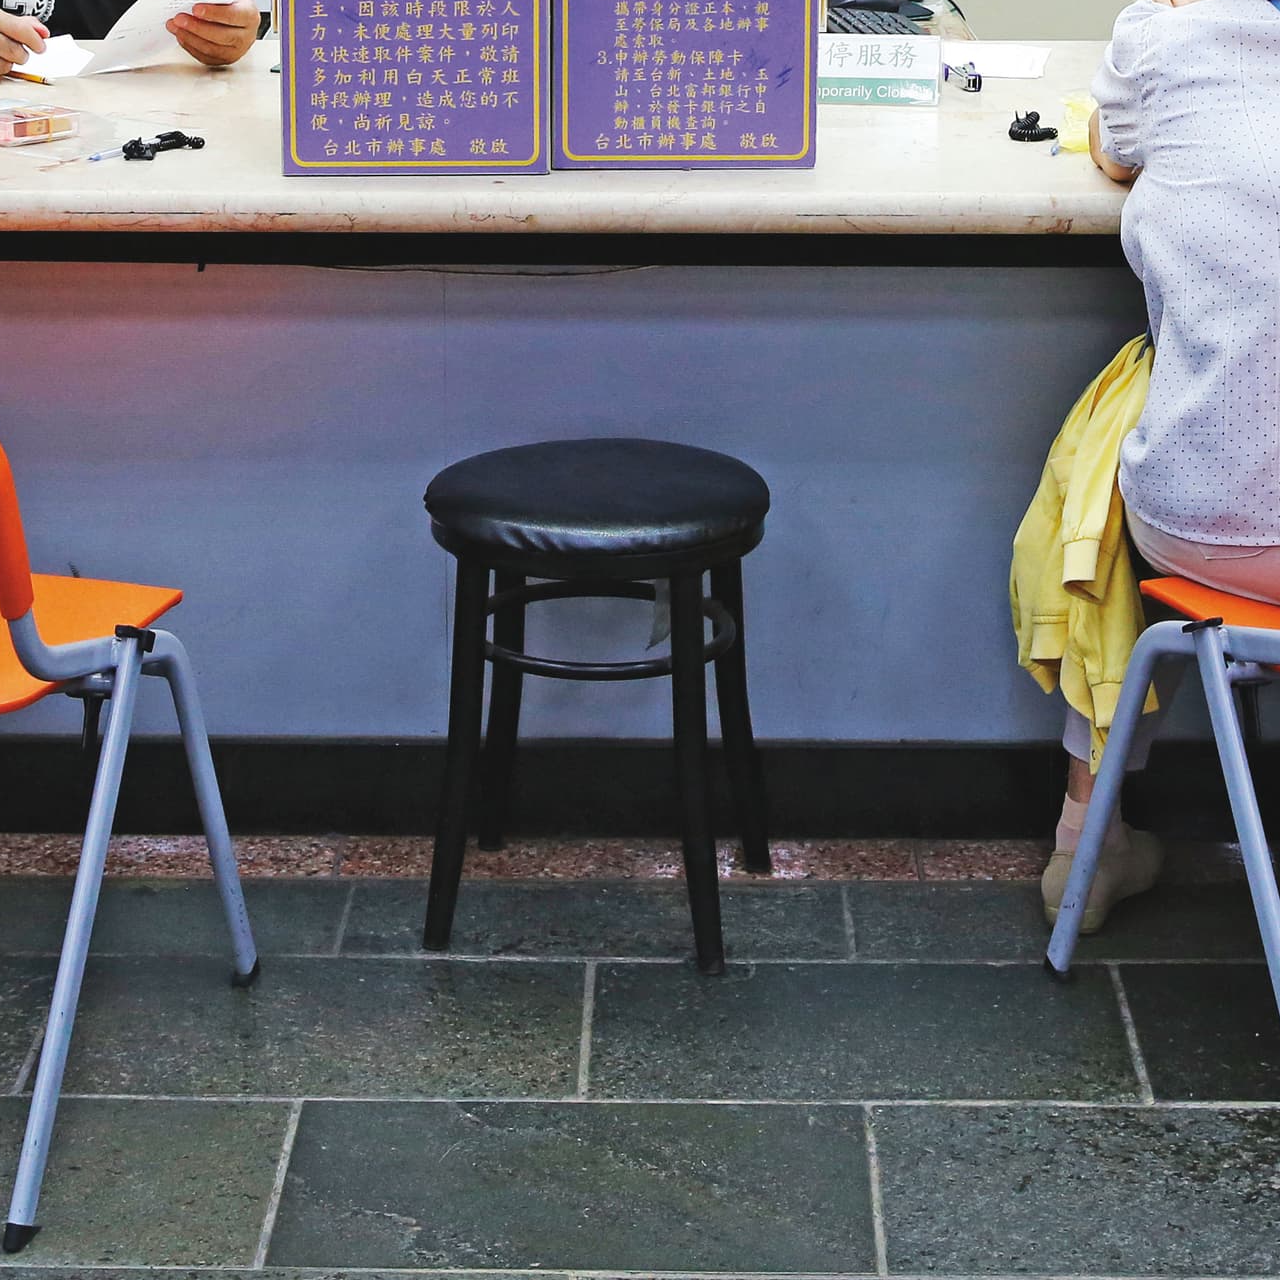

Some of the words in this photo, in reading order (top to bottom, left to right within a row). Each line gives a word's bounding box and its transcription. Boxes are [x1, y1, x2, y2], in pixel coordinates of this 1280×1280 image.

[312, 67, 520, 87] 多加利用白天正常班
[323, 137, 447, 156] 台北市辦事處
[470, 137, 509, 155] 敬啟
[595, 133, 717, 151] 台北市辦事處
[739, 133, 778, 149] 敬啟
